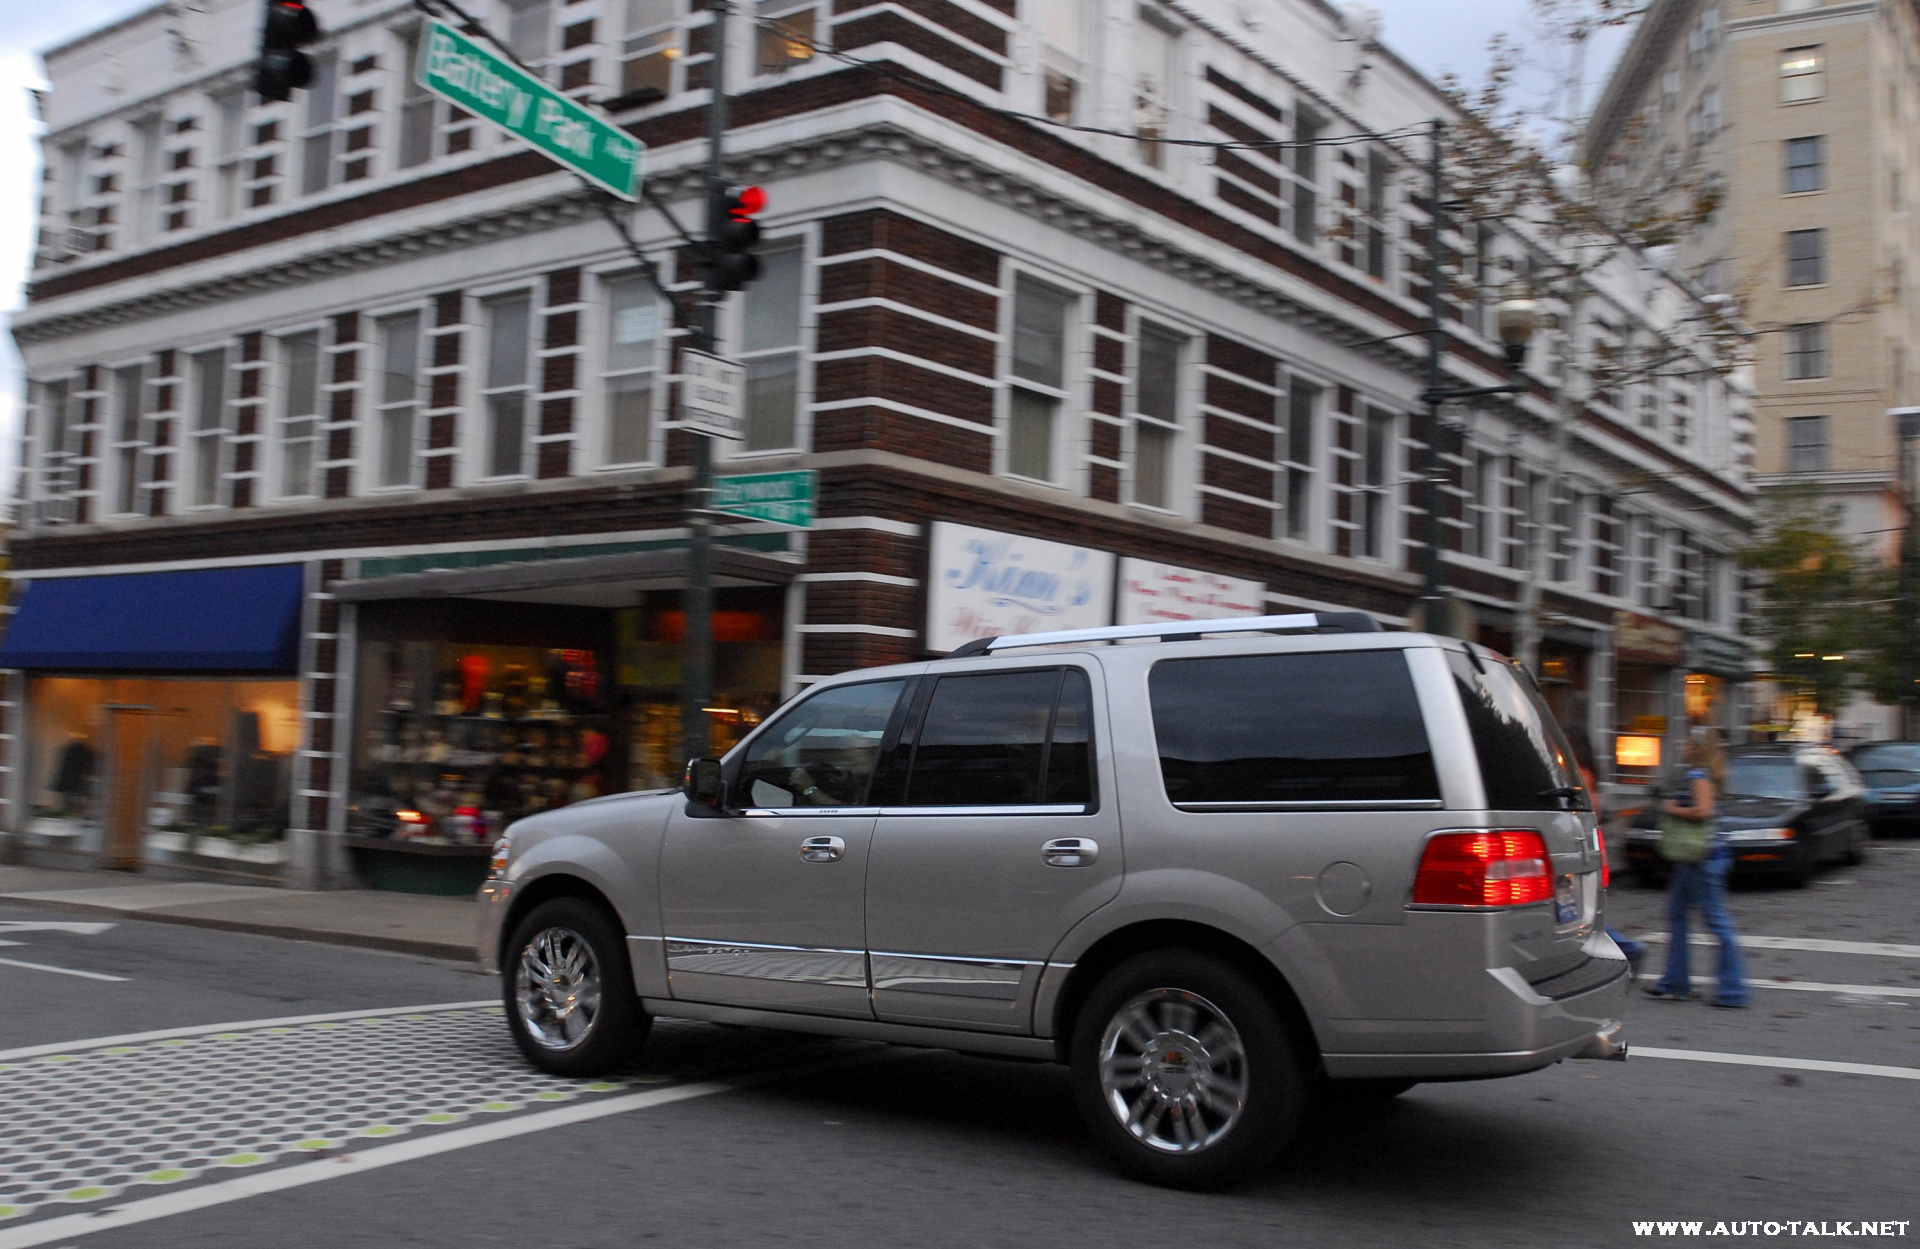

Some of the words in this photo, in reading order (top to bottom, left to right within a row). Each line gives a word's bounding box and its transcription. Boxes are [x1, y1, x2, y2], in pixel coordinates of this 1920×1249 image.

[427, 32, 532, 128] Battery
[534, 97, 596, 160] Park
[946, 537, 1092, 606] Kim's
